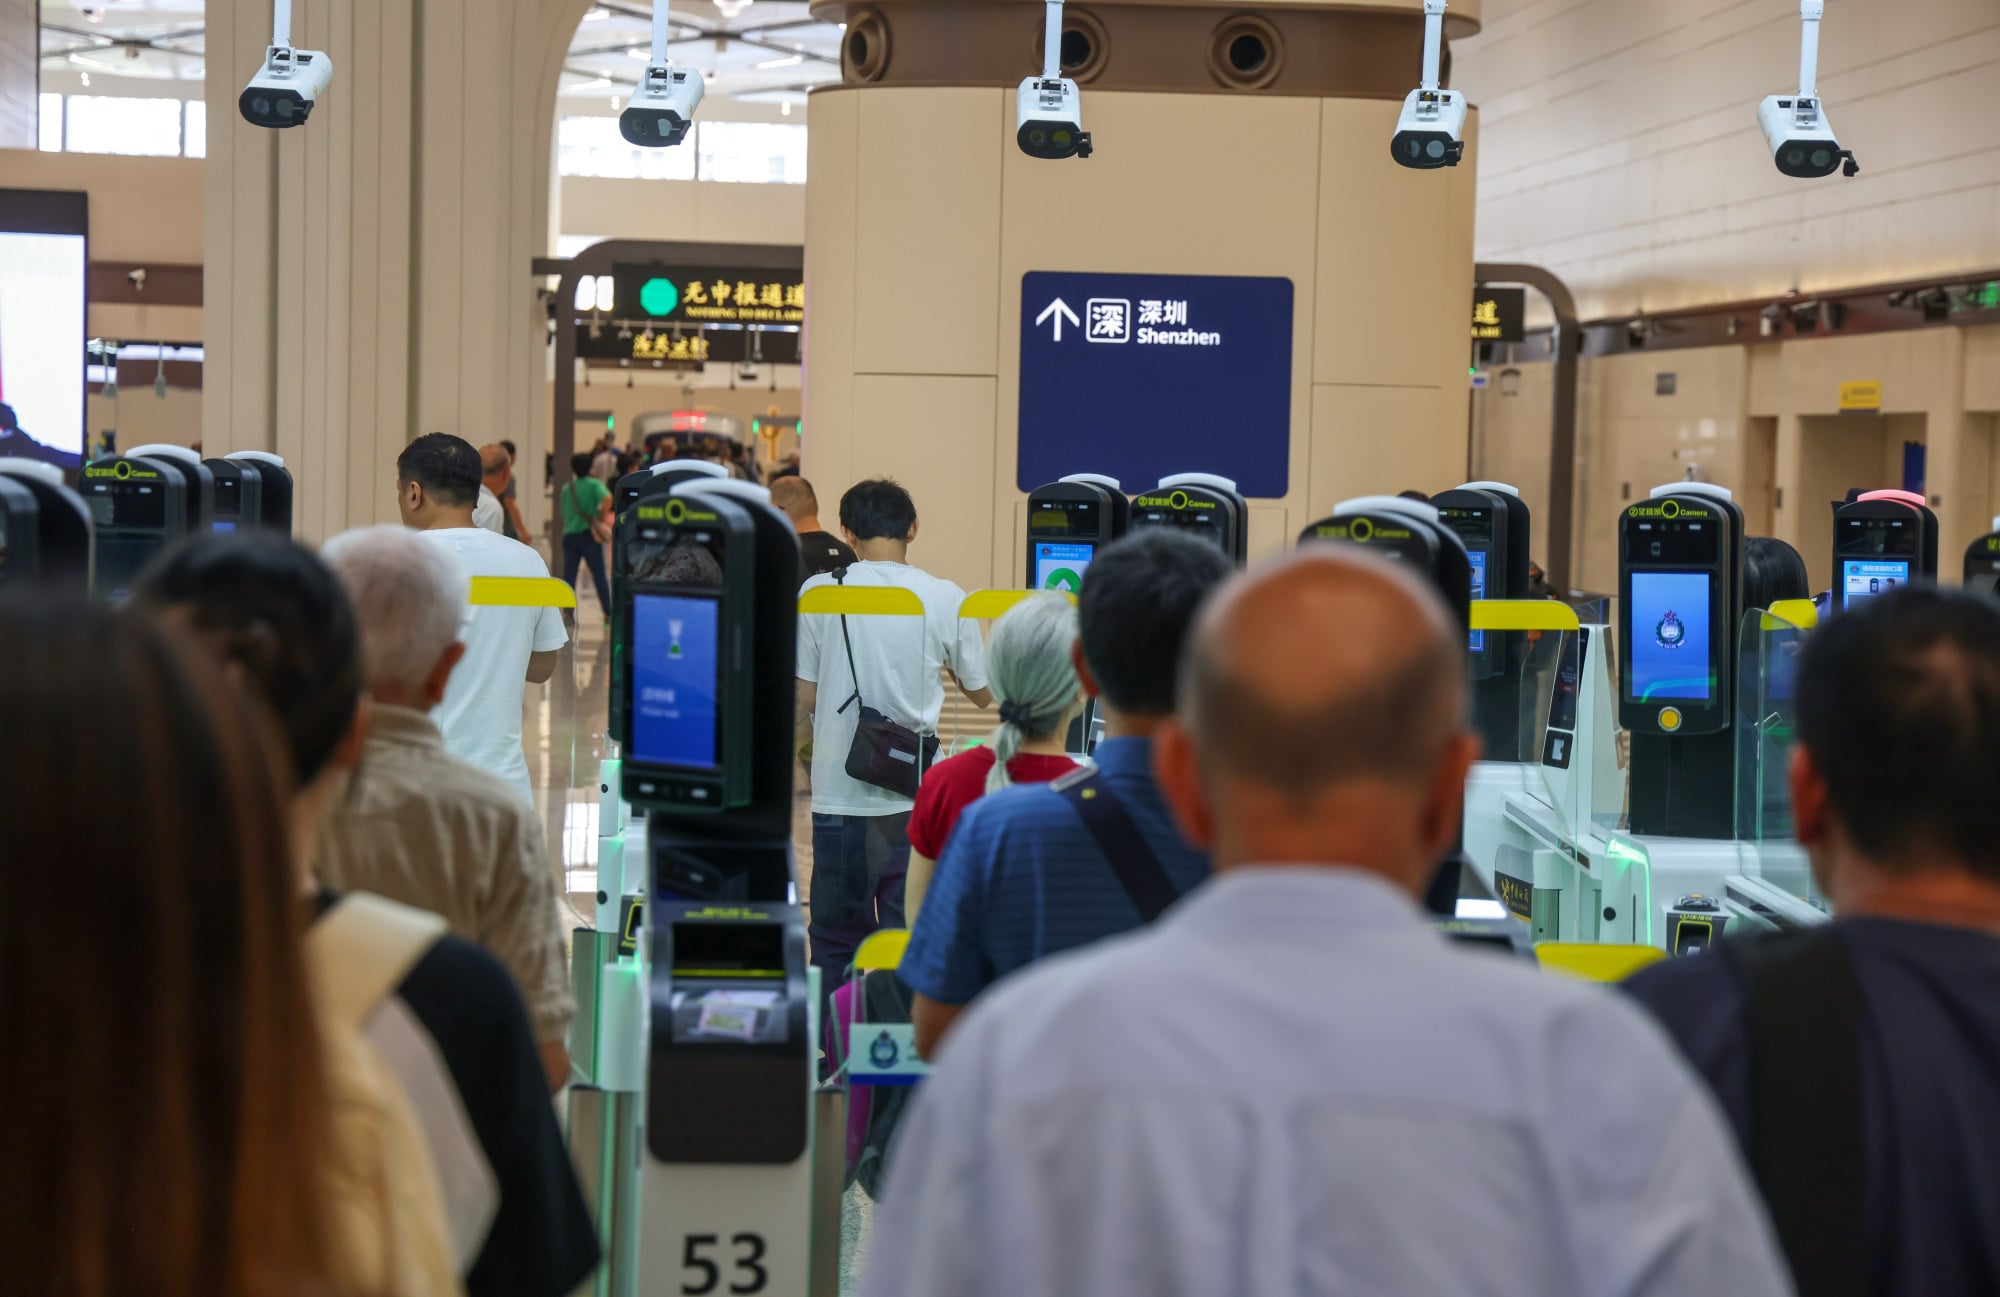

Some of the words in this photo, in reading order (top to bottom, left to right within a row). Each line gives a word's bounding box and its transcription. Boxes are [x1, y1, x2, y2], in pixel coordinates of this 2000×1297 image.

[1091, 304, 1125, 338] 深
[1137, 299, 1188, 326] 深圳
[1136, 326, 1221, 346] Shenzhen
[1188, 500, 1216, 509] Camera
[1680, 508, 1708, 517] Camera
[681, 1231, 768, 1296] 53
